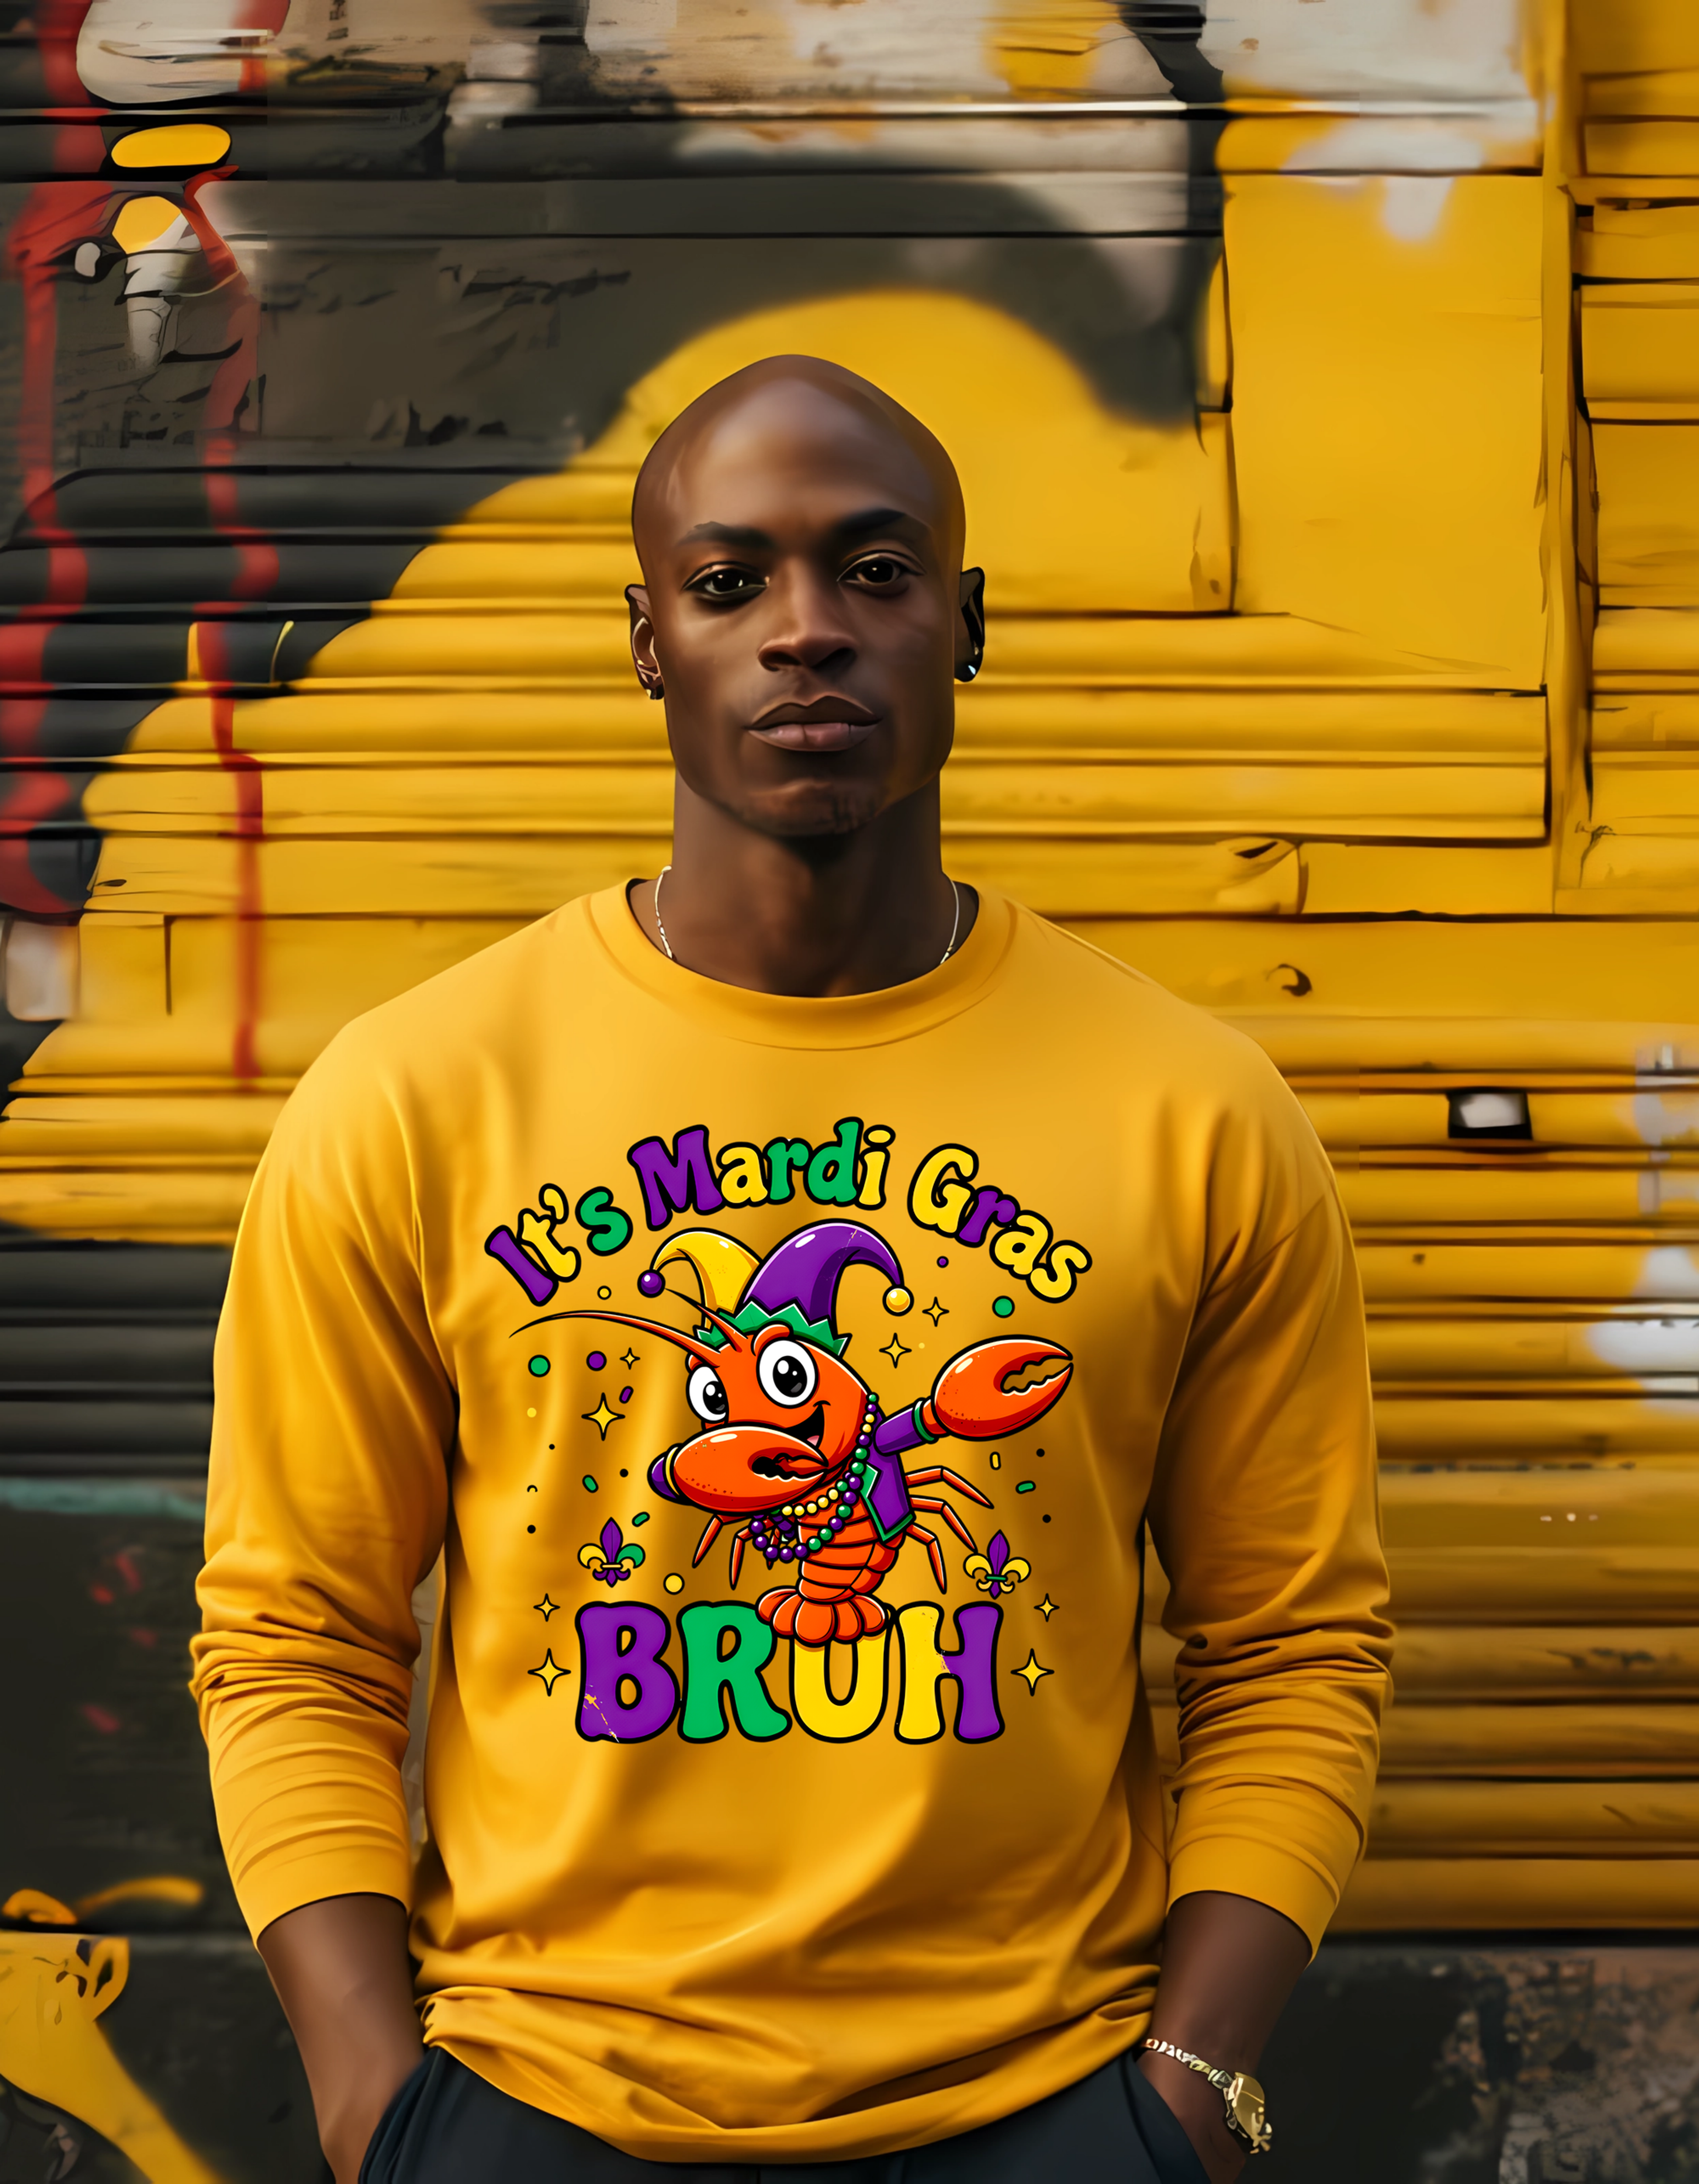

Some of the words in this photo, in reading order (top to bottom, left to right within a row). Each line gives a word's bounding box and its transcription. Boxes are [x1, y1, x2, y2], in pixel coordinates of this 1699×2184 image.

[485, 1184, 632, 1305] It's
[627, 1116, 895, 1231] Mardi
[908, 1143, 1093, 1302] Gras
[575, 1601, 1004, 1744] BRUH
